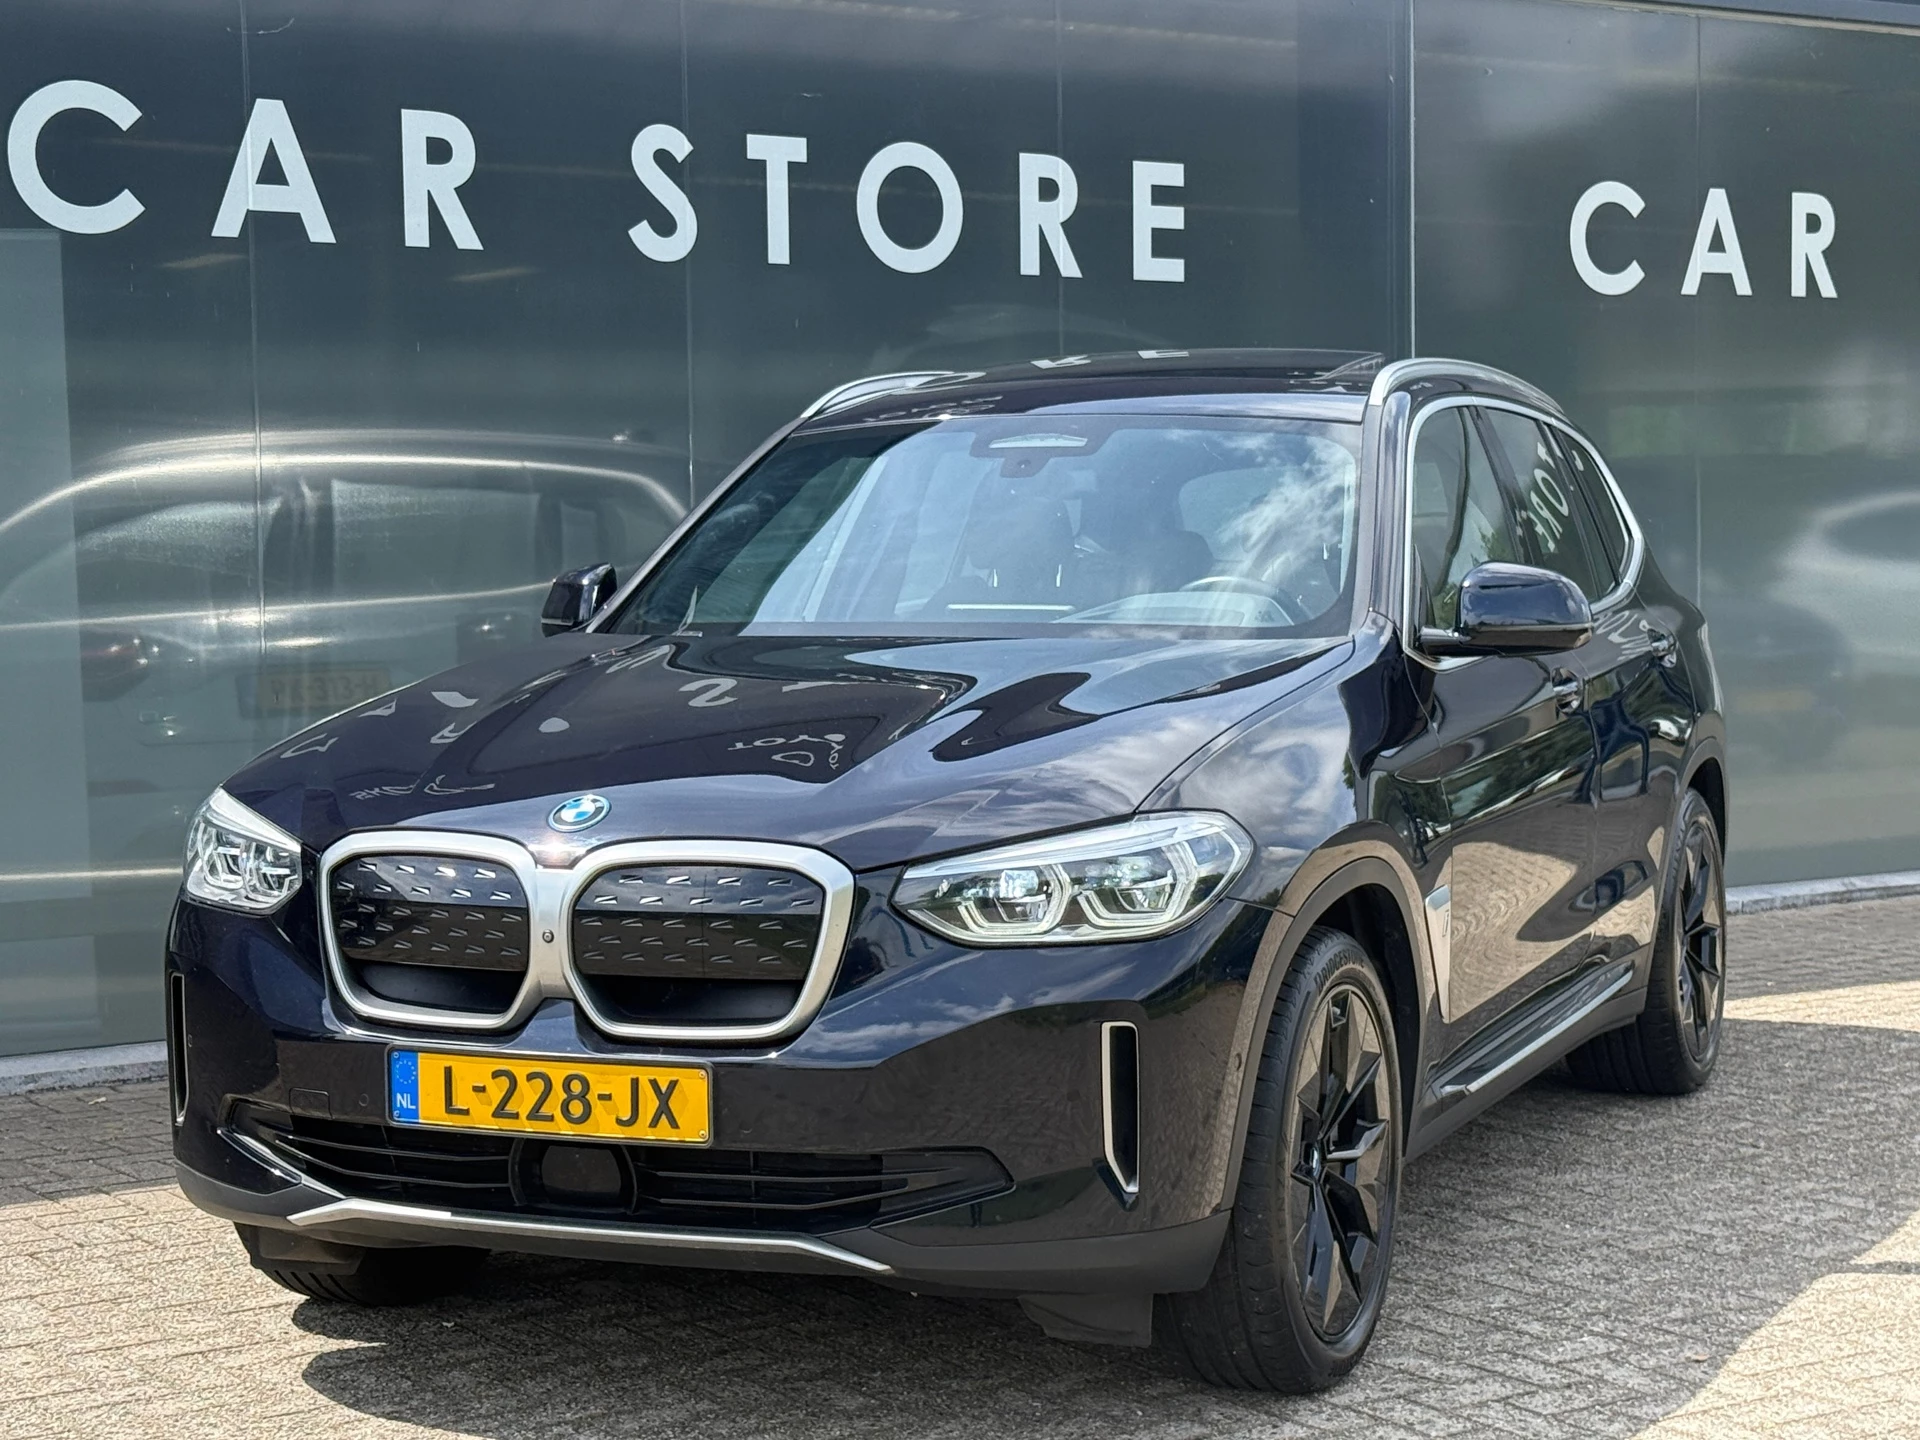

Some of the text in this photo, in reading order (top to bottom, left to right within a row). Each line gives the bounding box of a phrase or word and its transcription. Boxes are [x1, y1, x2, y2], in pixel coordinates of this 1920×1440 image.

[7, 79, 1185, 283] CAR STORE
[1569, 180, 1839, 299] CAR
[396, 1092, 416, 1109] NL
[443, 1065, 681, 1130] L-228-JX
